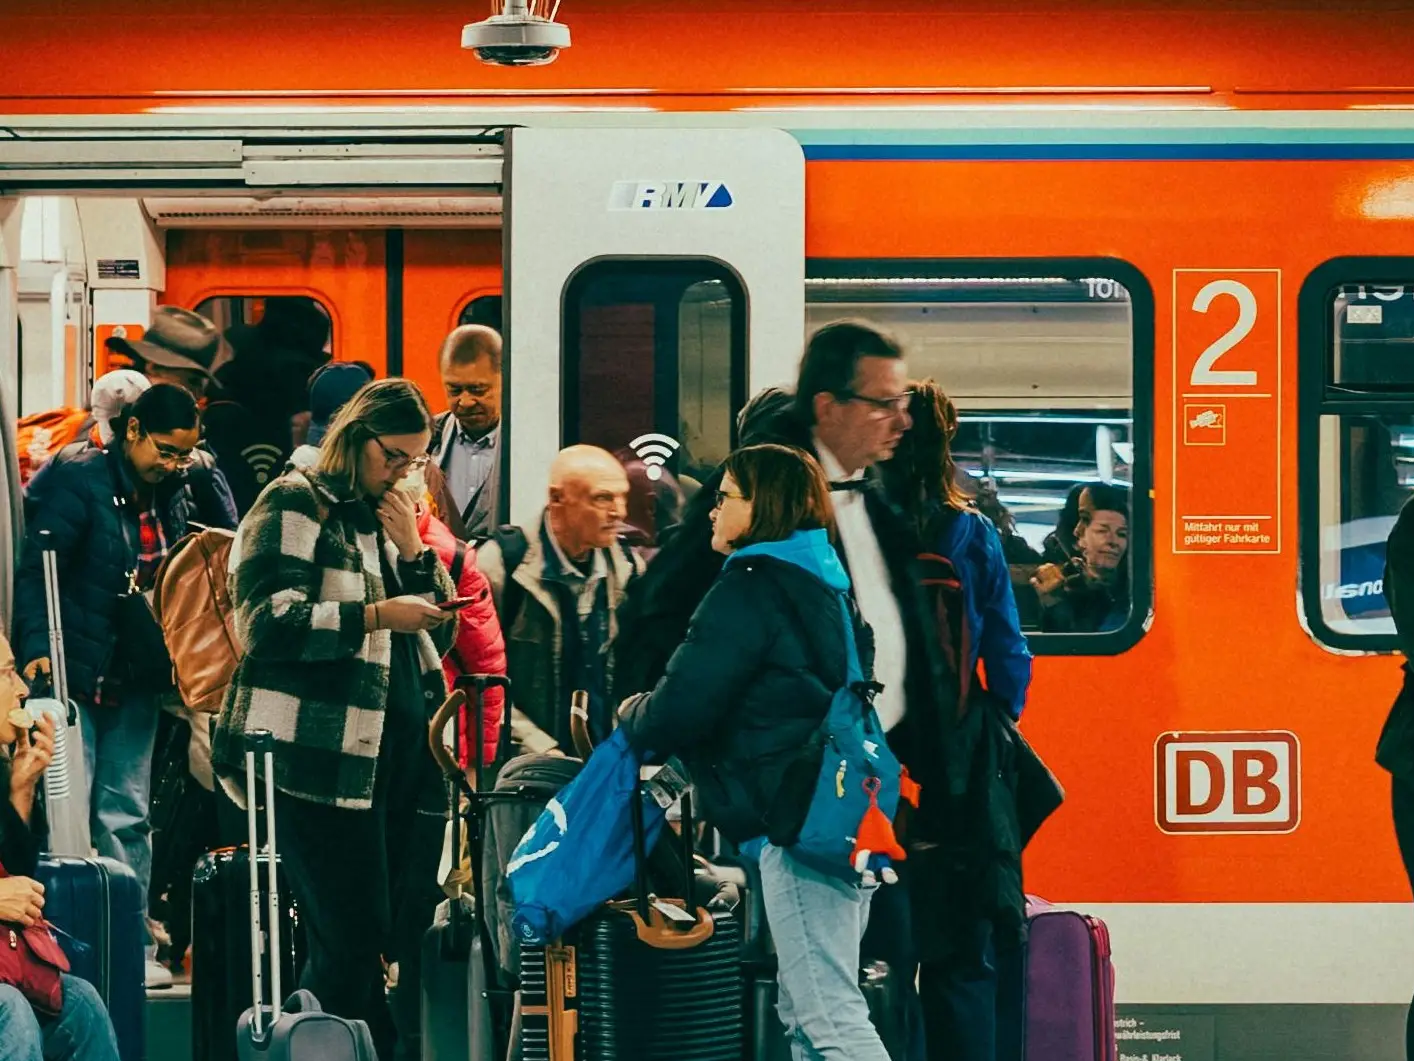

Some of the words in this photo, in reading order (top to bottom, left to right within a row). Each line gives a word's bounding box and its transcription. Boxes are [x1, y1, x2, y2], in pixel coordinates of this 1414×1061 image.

[631, 181, 723, 209] RMV
[1190, 280, 1257, 385] 2
[1184, 522, 1222, 532] Mitfahrt
[1224, 524, 1241, 532] nur
[1243, 522, 1259, 532] mit
[1184, 533, 1222, 545] gültiger
[1223, 533, 1271, 543] Fahrkarte
[1176, 750, 1281, 815] DB
